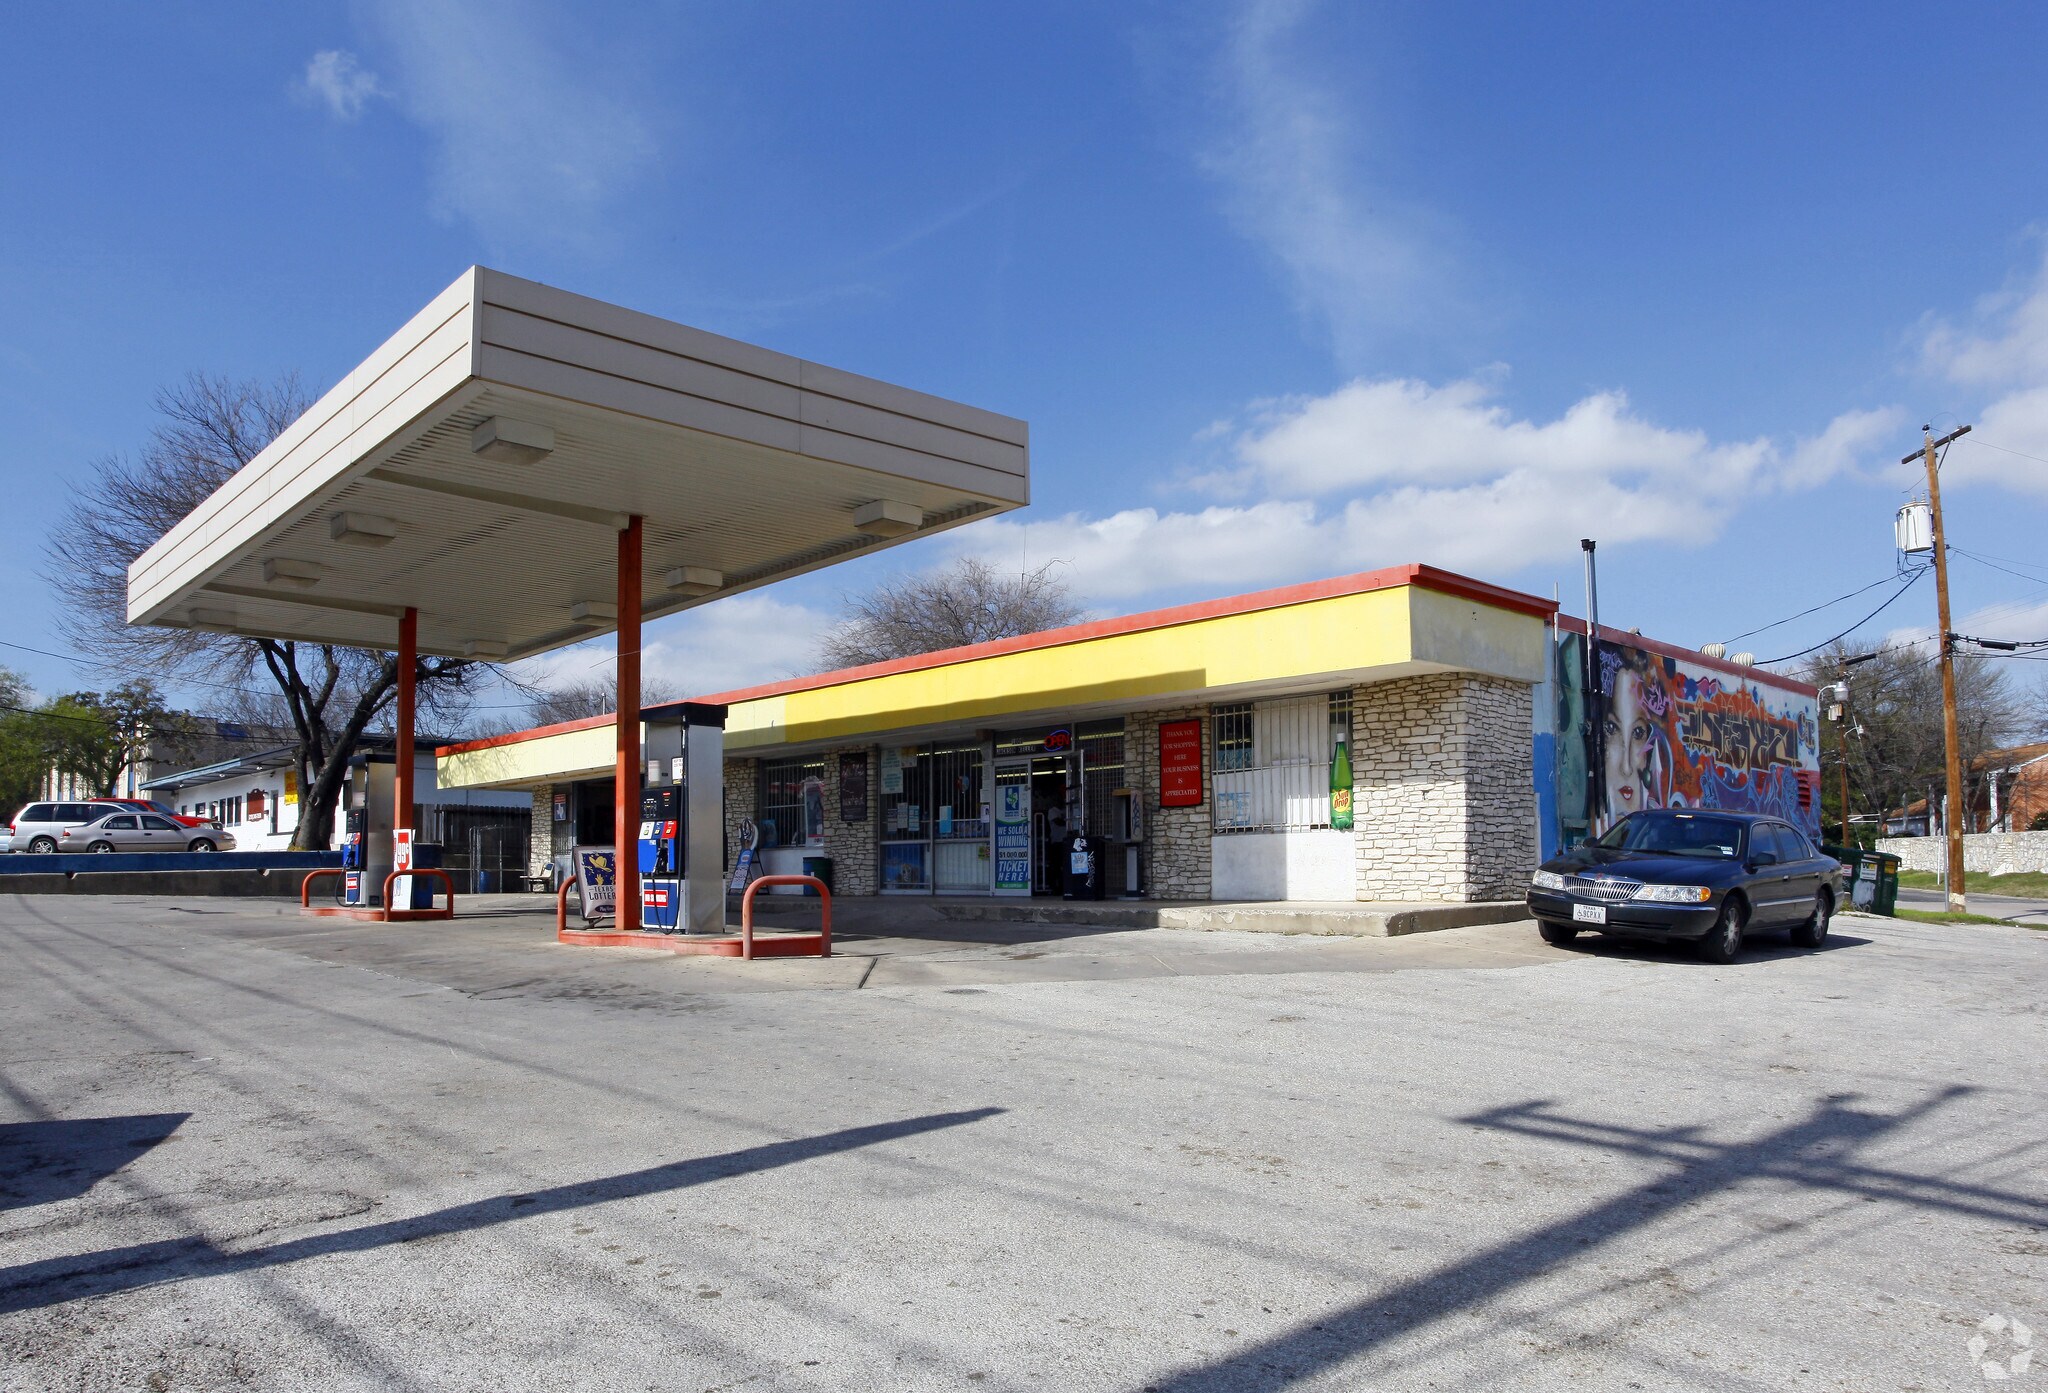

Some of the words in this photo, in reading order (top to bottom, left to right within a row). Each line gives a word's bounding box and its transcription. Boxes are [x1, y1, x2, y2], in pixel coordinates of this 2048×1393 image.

[1166, 730, 1183, 738] THANK
[1044, 733, 1070, 748] OPEN
[1173, 741, 1198, 749] SHOPPING
[1165, 789, 1197, 797] APPRECIATED
[1336, 789, 1348, 800] Sun
[1334, 797, 1349, 808] Drop
[998, 826, 1007, 835] WE
[1008, 826, 1023, 835] SOLD
[1023, 825, 1028, 834] A
[998, 835, 1028, 847] WINNING
[999, 860, 1028, 872] TICKET
[998, 872, 1028, 881] HERE!
[589, 892, 616, 900] LOTTER
